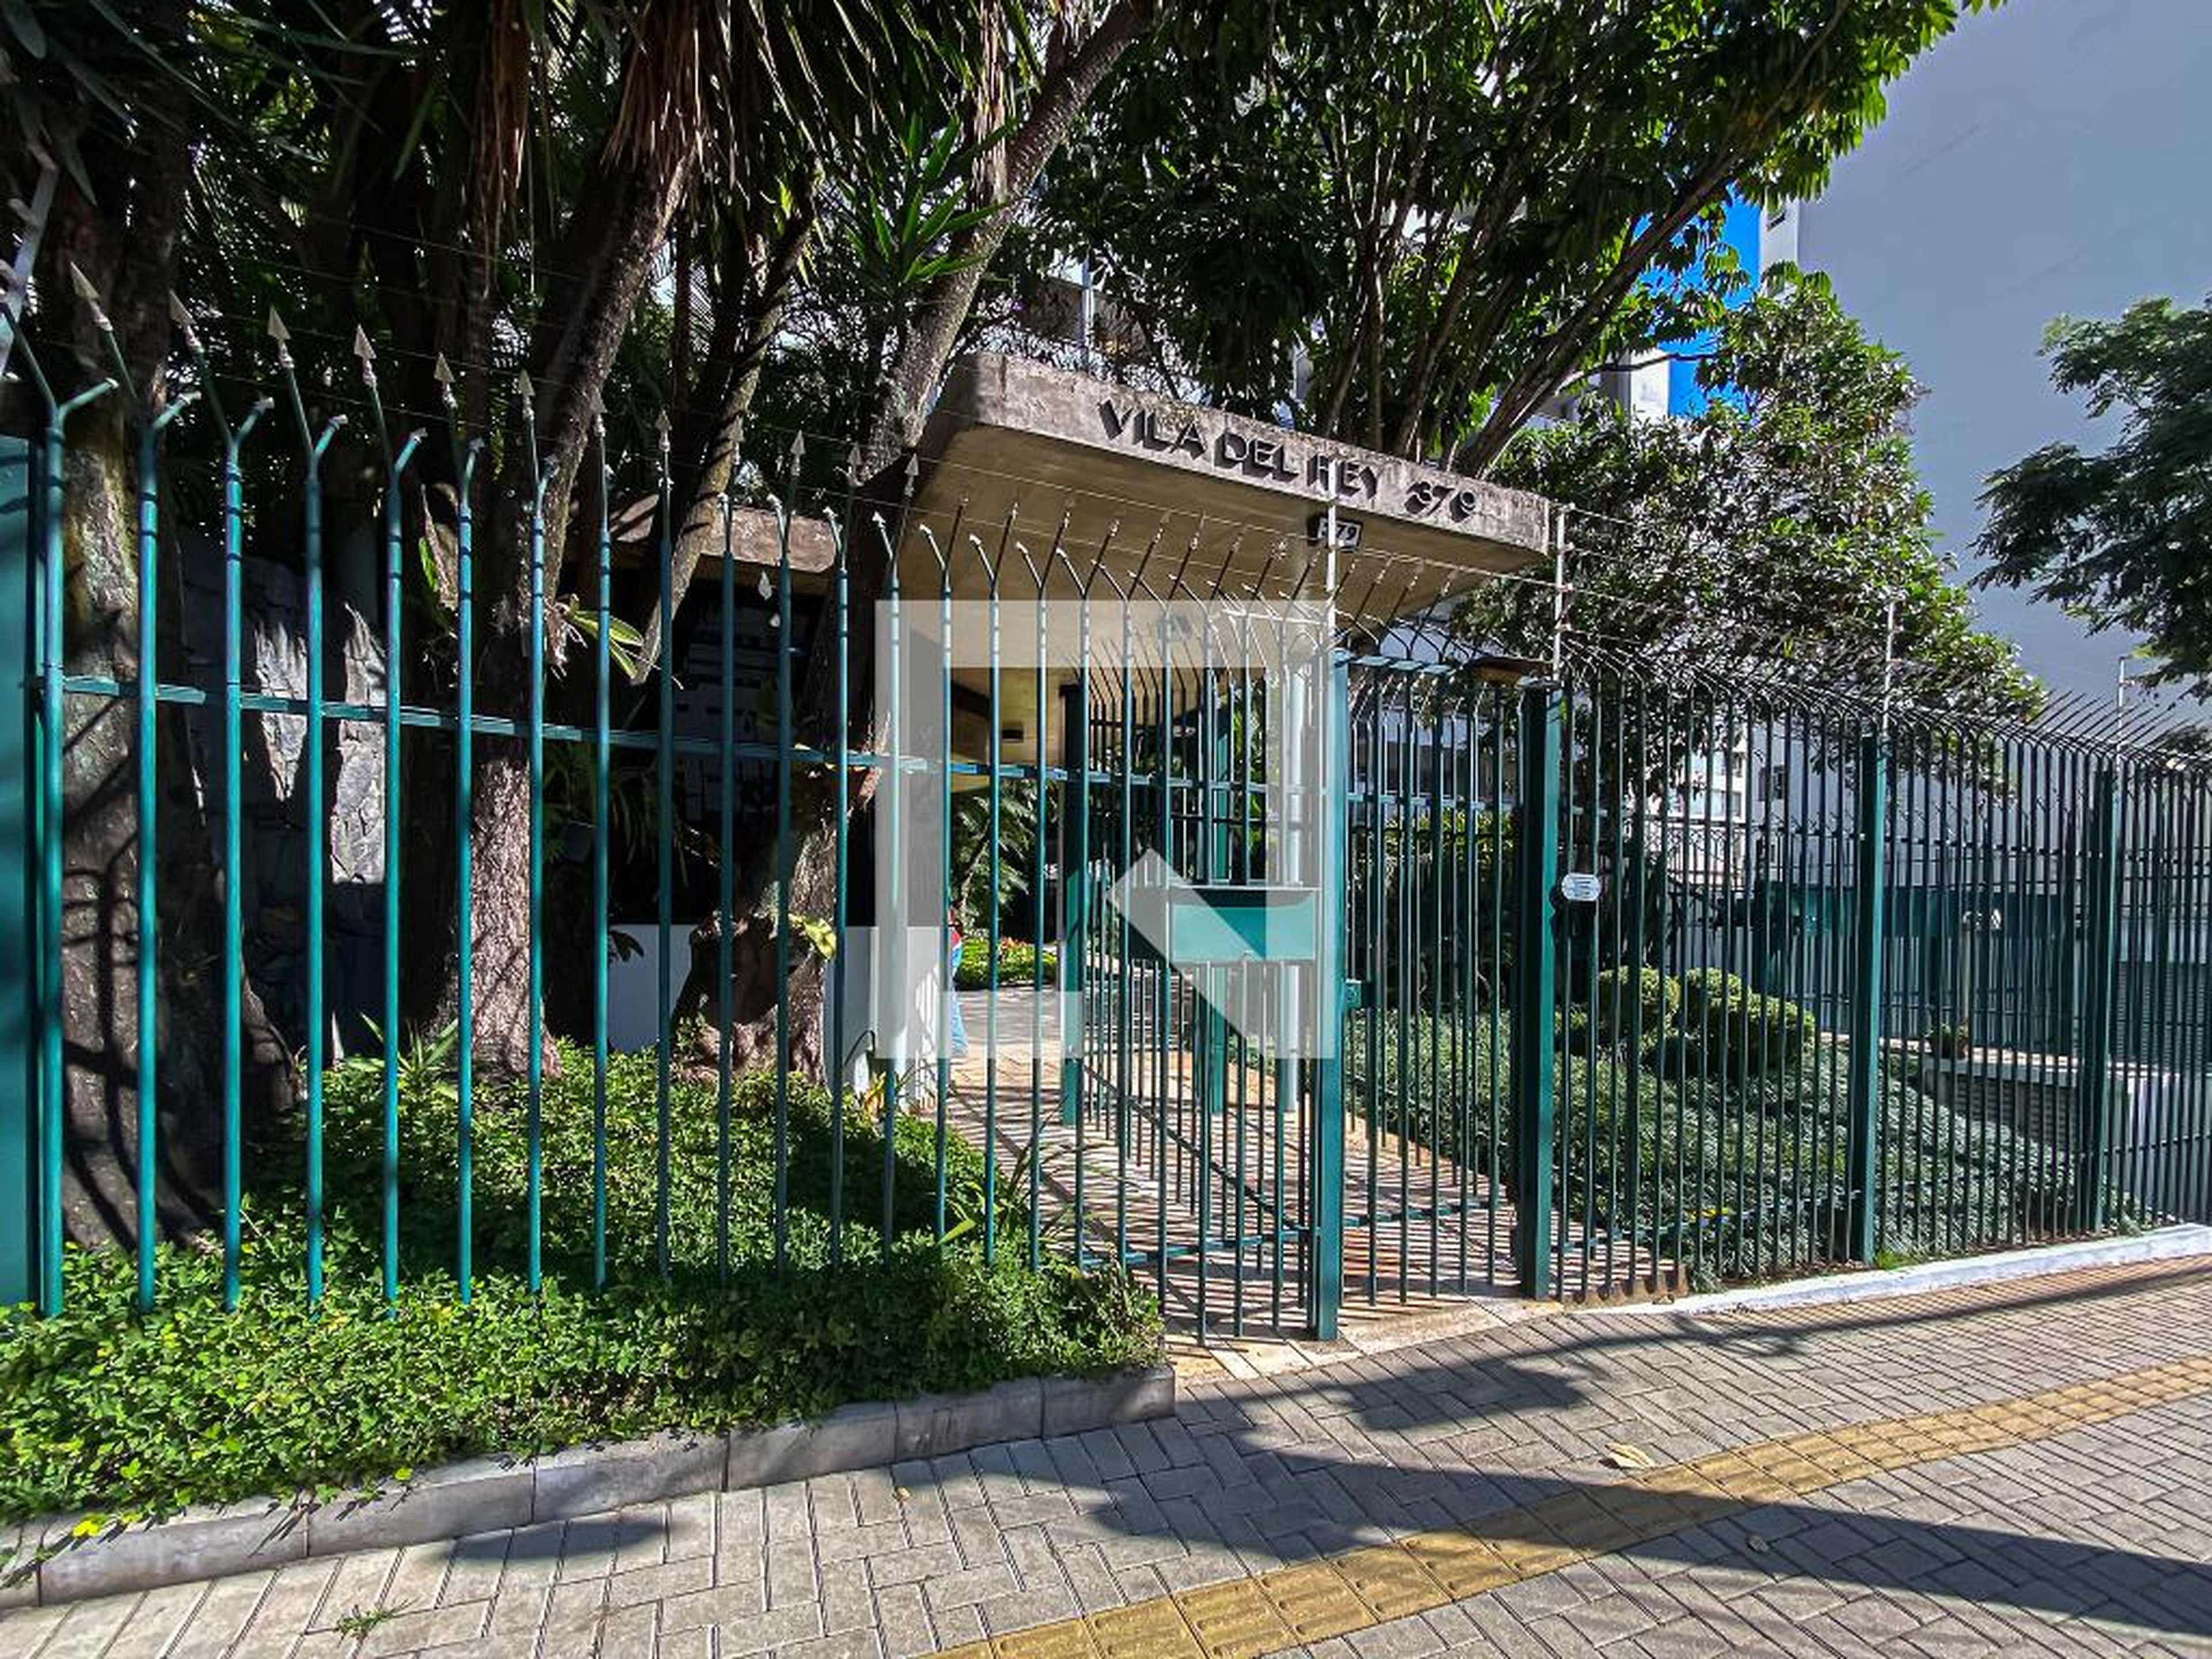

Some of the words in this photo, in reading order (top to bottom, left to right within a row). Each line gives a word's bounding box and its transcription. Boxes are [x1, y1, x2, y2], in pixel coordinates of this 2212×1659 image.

[1097, 399, 1207, 460] VILA
[1214, 433, 1299, 483] DEL
[1306, 453, 1381, 499] REY
